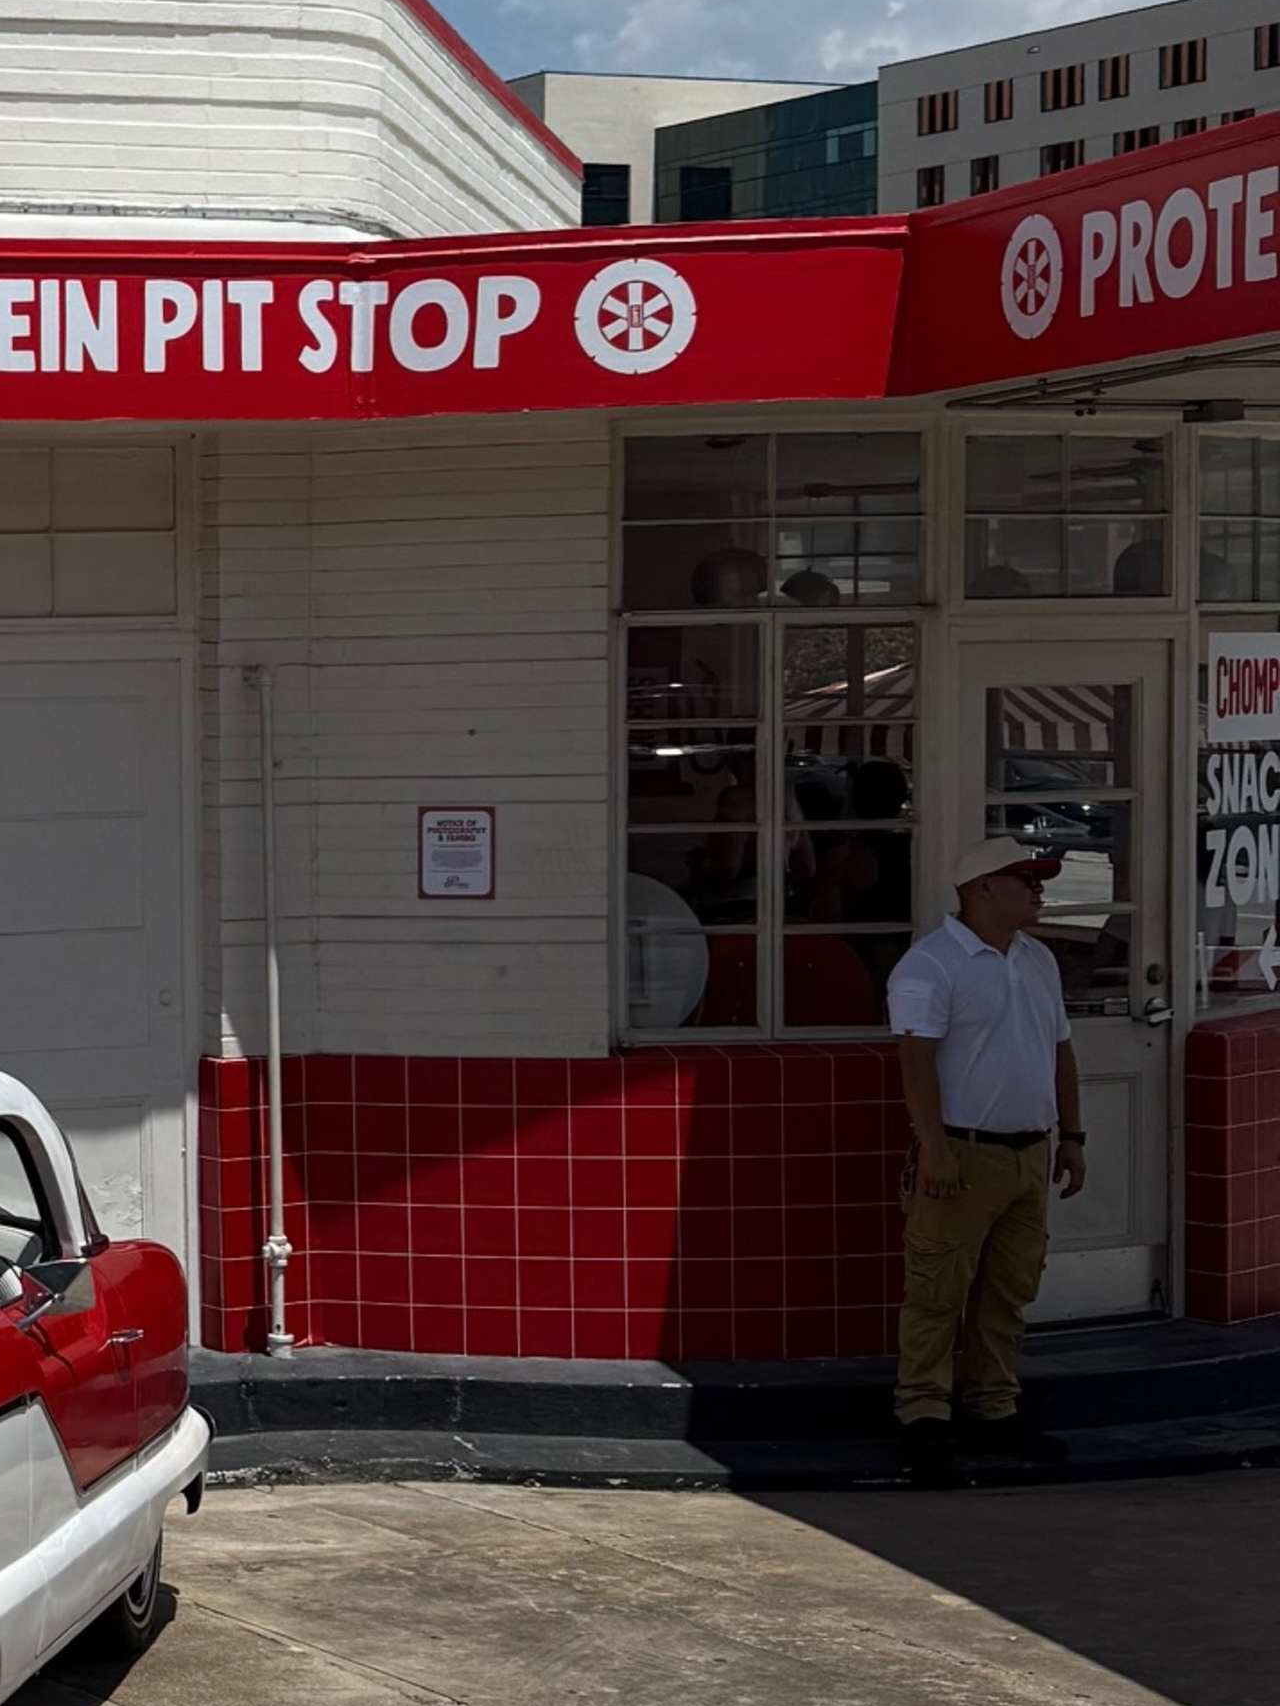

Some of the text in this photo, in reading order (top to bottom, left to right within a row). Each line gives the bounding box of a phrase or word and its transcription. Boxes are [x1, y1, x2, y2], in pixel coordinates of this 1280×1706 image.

[1080, 166, 1279, 317] PROTE
[144, 279, 273, 373] PIT
[298, 276, 541, 373] STOP
